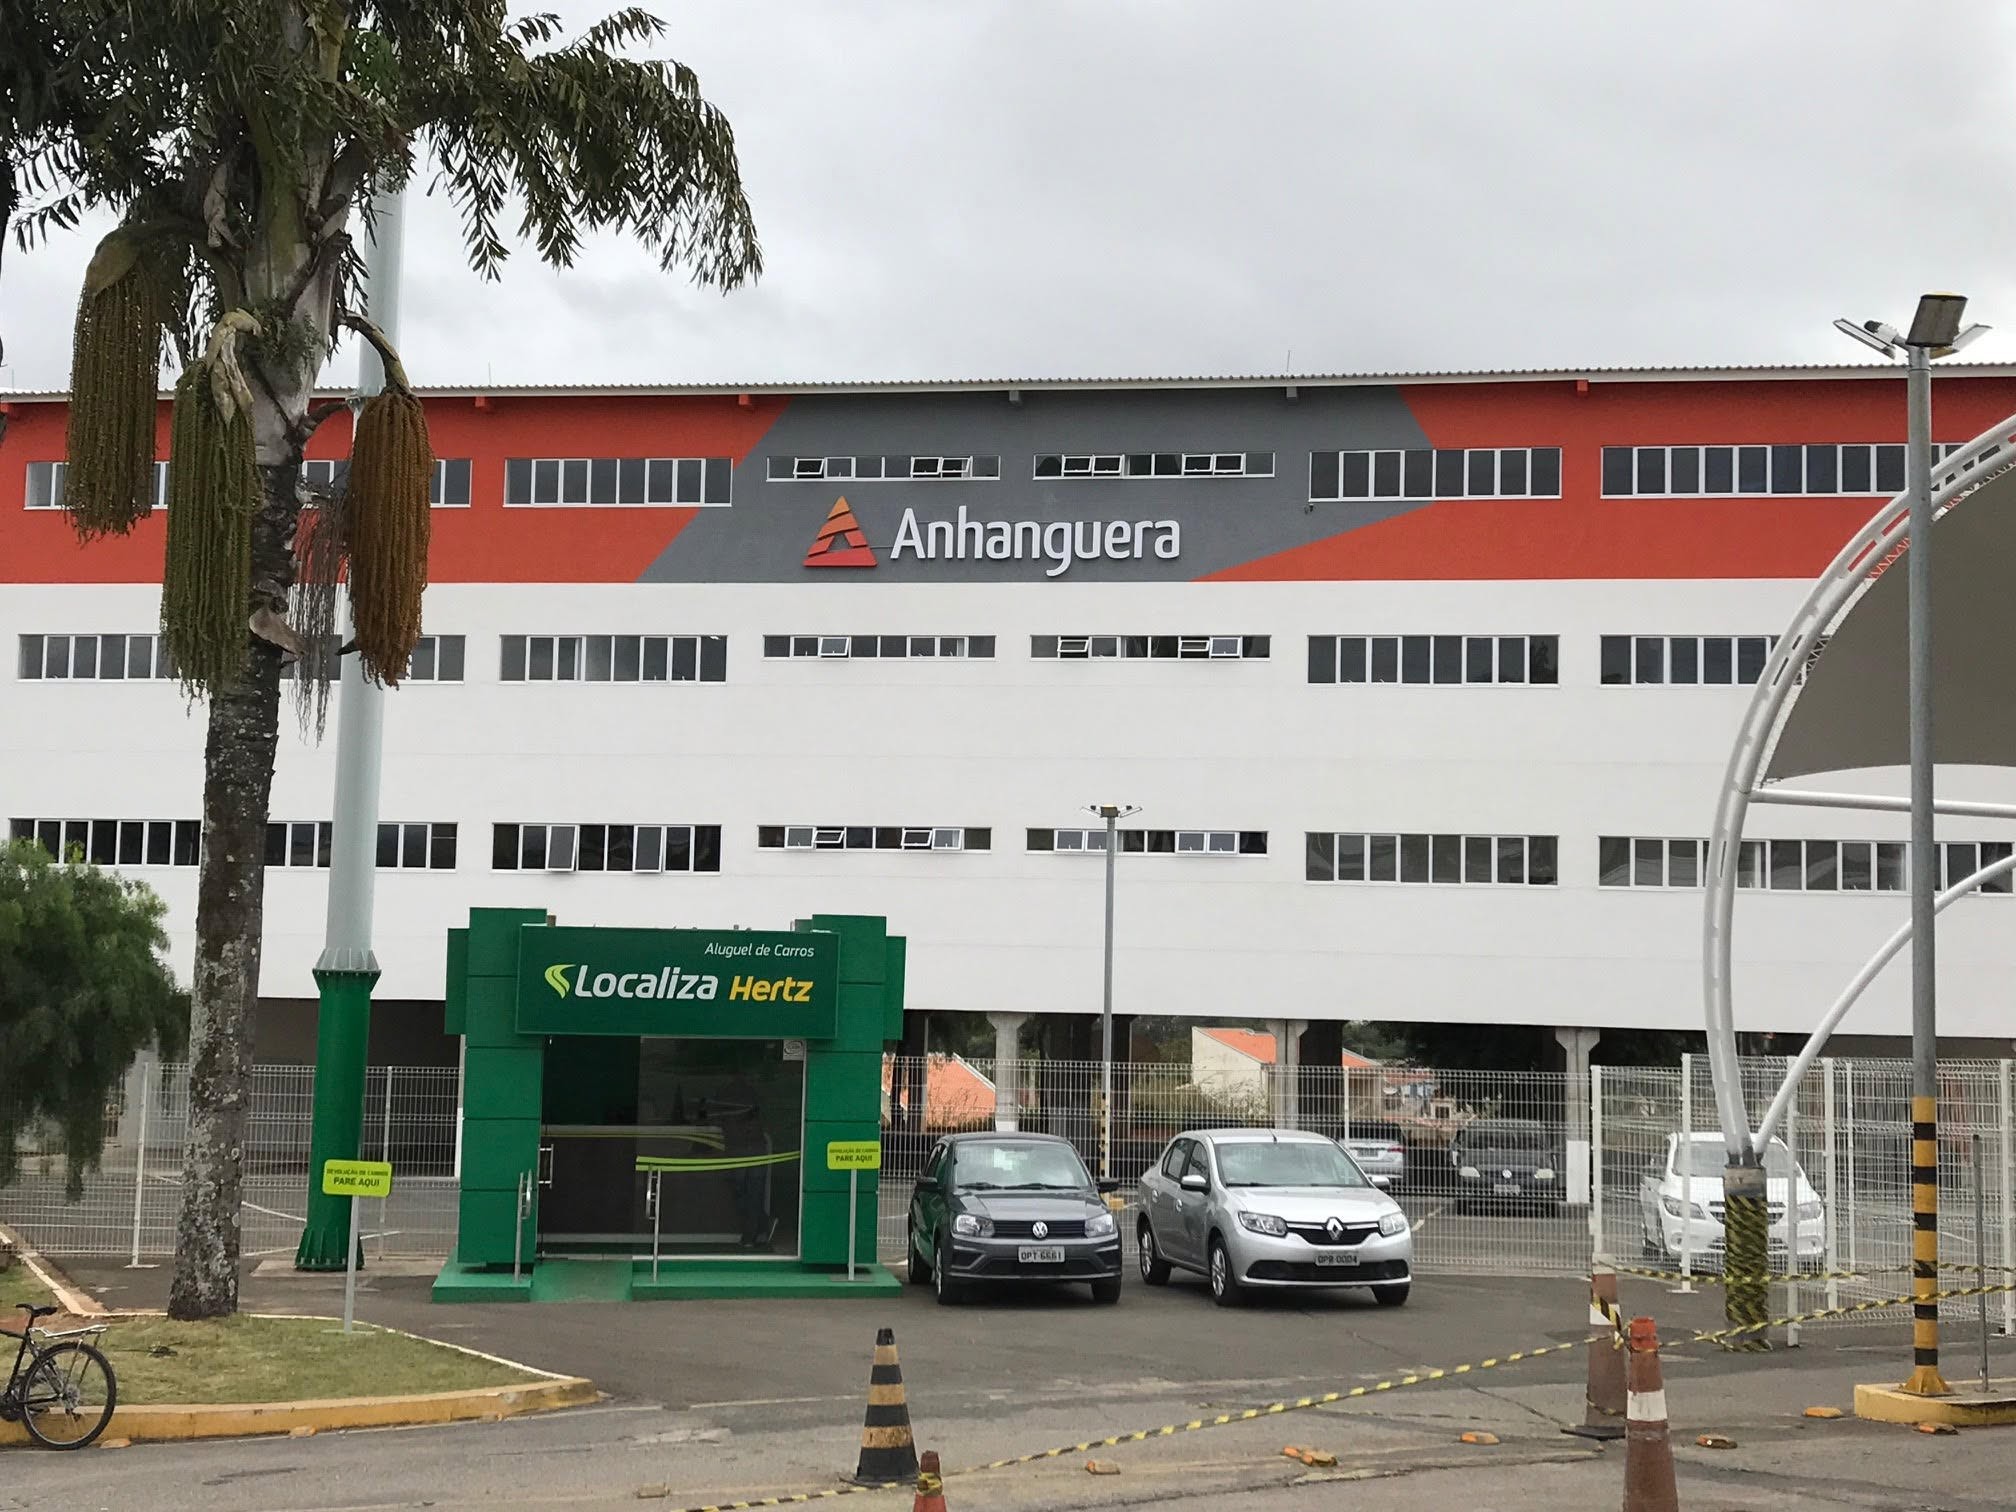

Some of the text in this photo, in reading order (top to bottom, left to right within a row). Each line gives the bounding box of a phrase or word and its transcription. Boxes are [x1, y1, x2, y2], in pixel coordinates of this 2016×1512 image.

[890, 505, 1180, 577] Anhanguera
[704, 943, 815, 958] Aluguel de Carros
[574, 965, 814, 1002] Localiza Hertz
[333, 1177, 379, 1187] PARE AQUI
